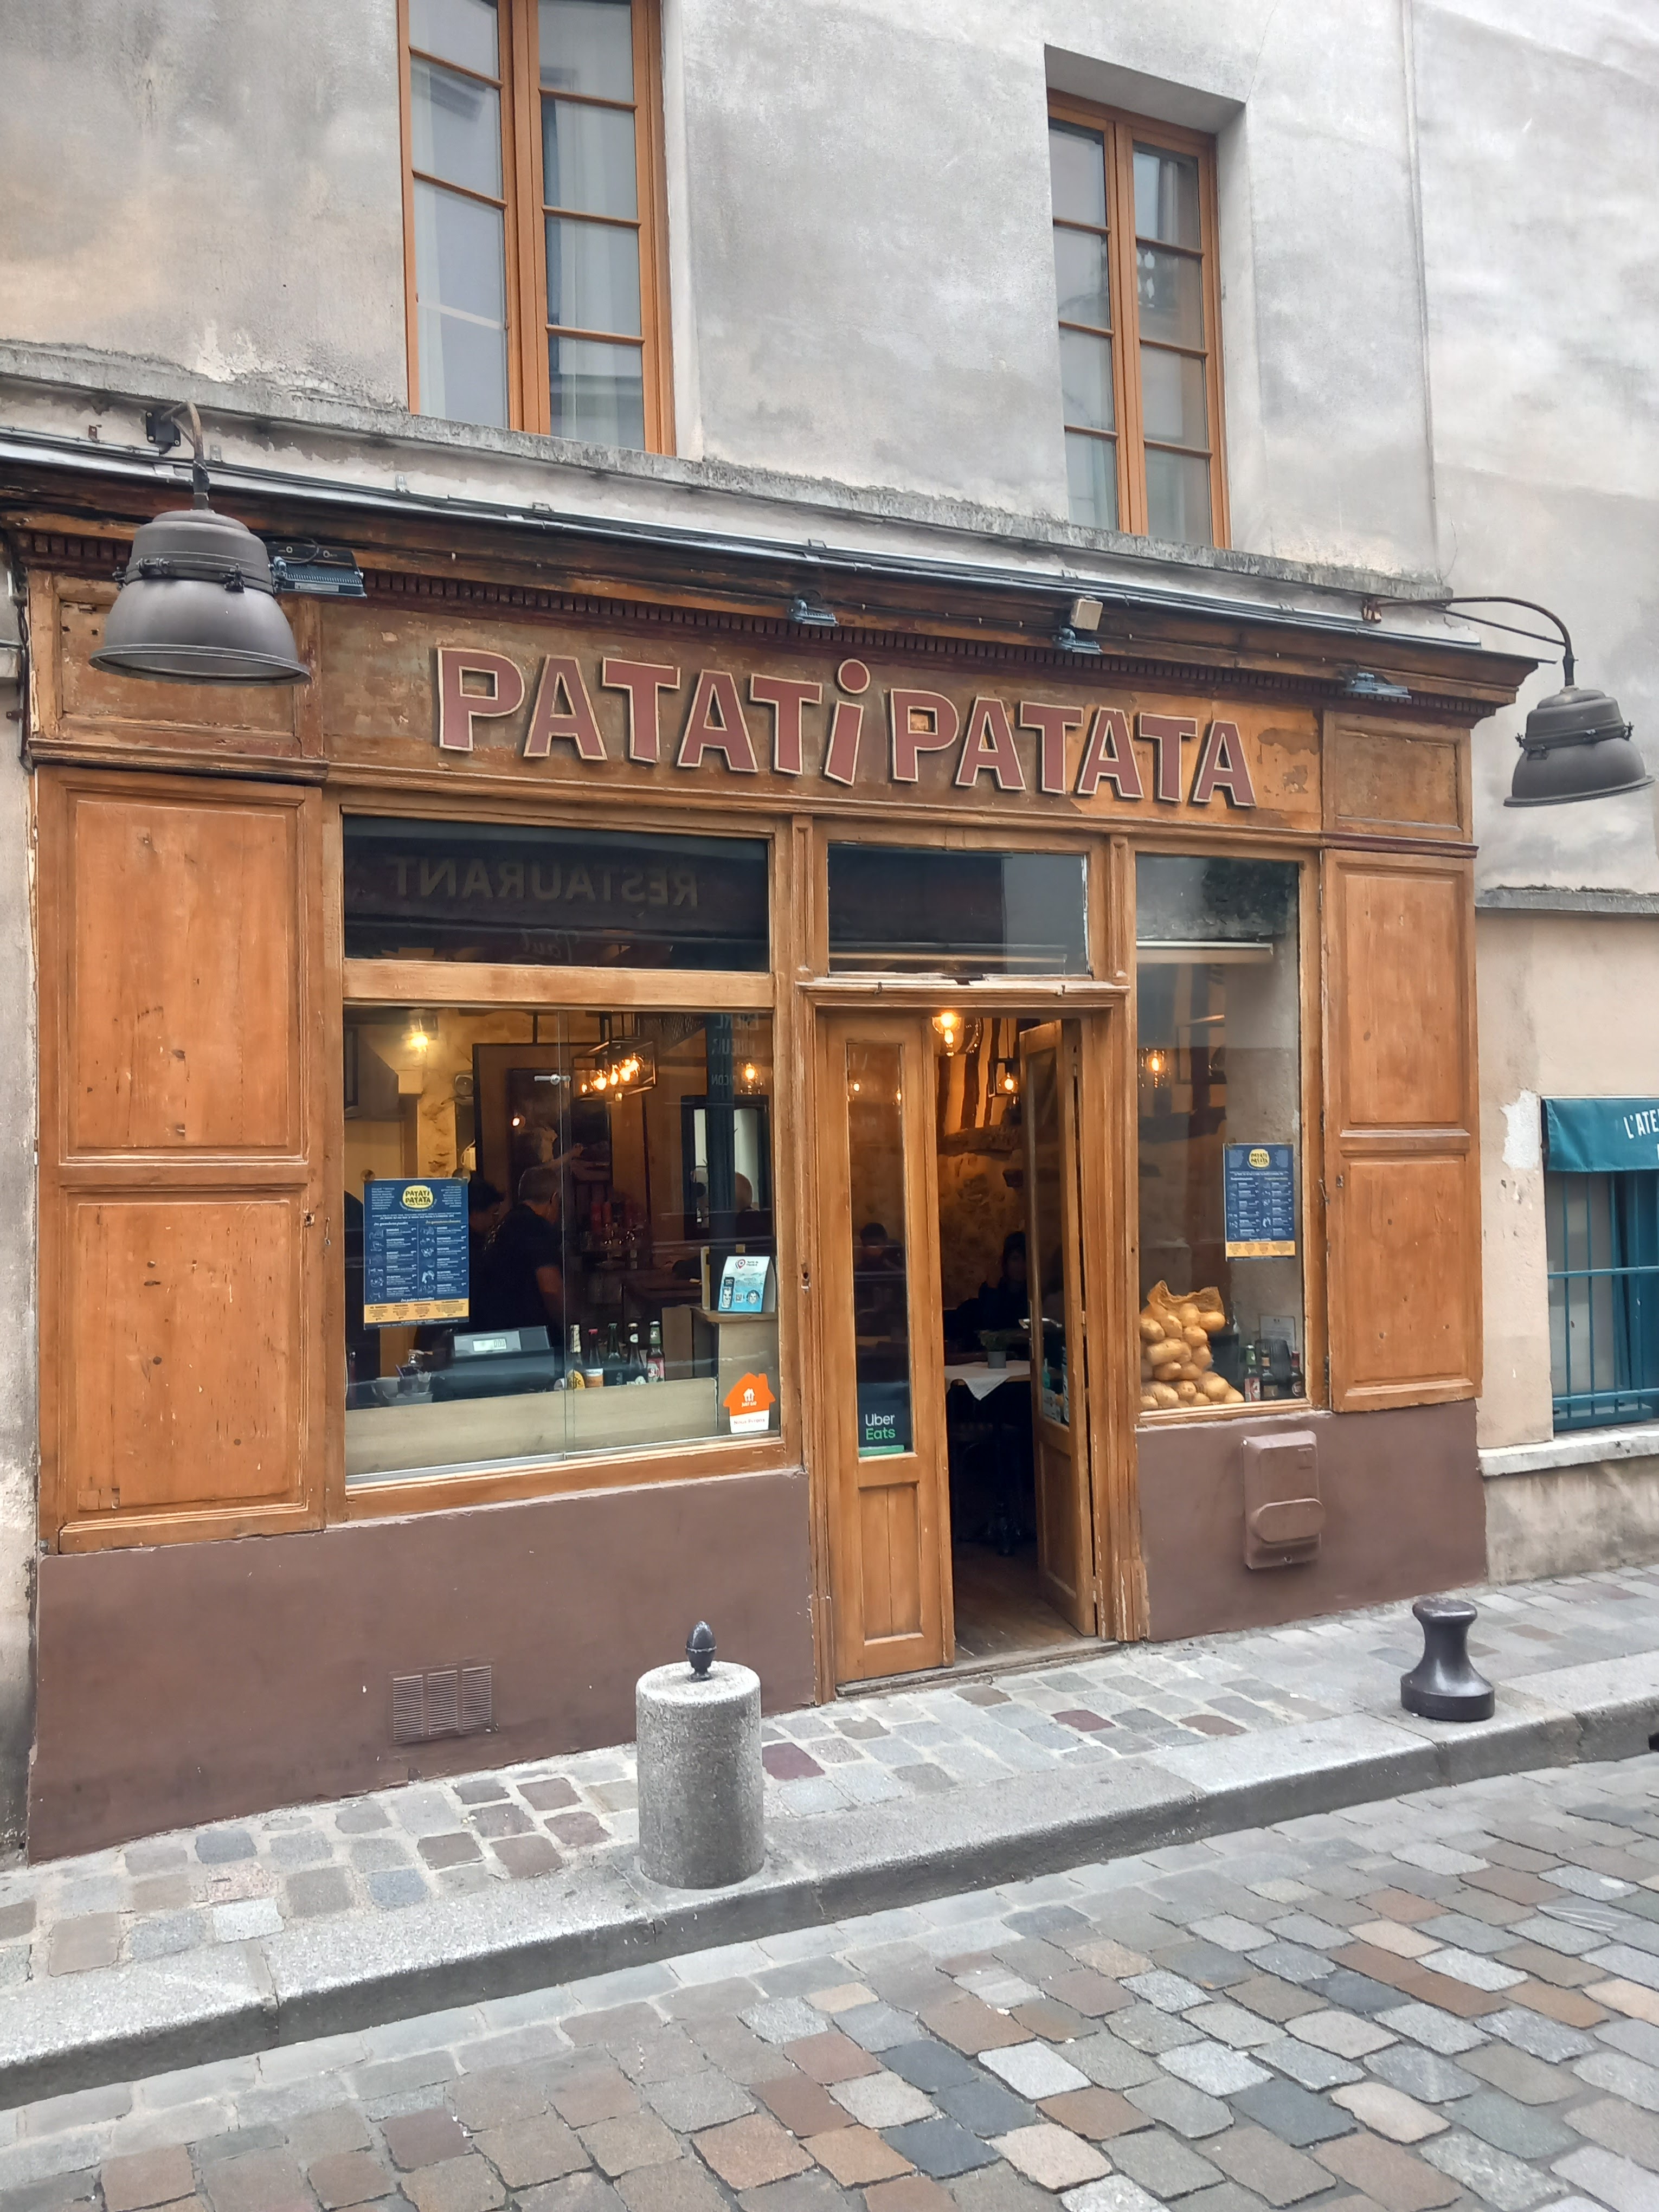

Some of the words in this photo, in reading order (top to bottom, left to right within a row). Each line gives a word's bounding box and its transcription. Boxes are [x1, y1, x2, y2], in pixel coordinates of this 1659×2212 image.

[889, 687, 1257, 809] PATATA
[865, 1413, 895, 1426] Uber
[866, 1427, 896, 1441] Eats
